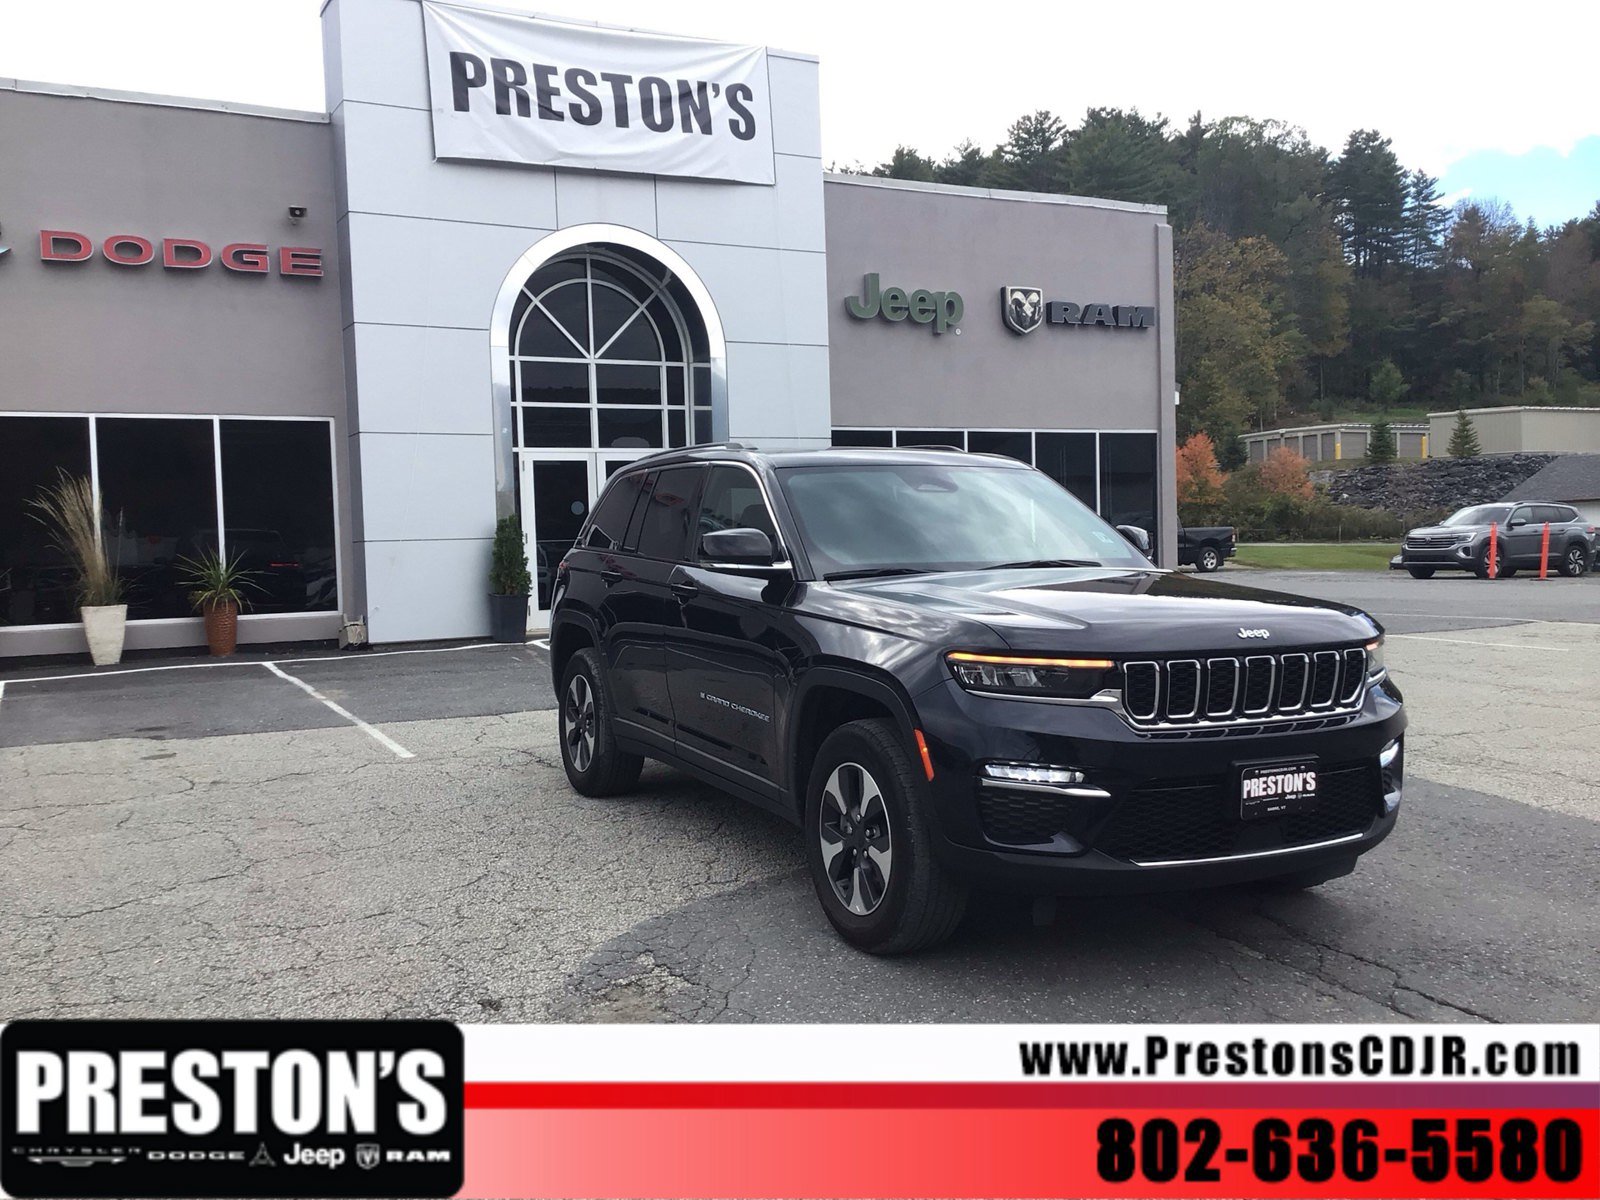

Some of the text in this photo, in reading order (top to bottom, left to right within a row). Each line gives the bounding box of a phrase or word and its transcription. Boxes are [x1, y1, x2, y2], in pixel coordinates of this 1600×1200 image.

[450, 51, 757, 141] PRESTON'S
[39, 230, 325, 278] DODGE
[845, 272, 964, 334] Jeep
[1047, 301, 1155, 329] RAM
[1238, 627, 1270, 639] Jeep
[706, 694, 770, 722] GRAND CHEROKEE
[1243, 772, 1316, 798] PRESTON'S
